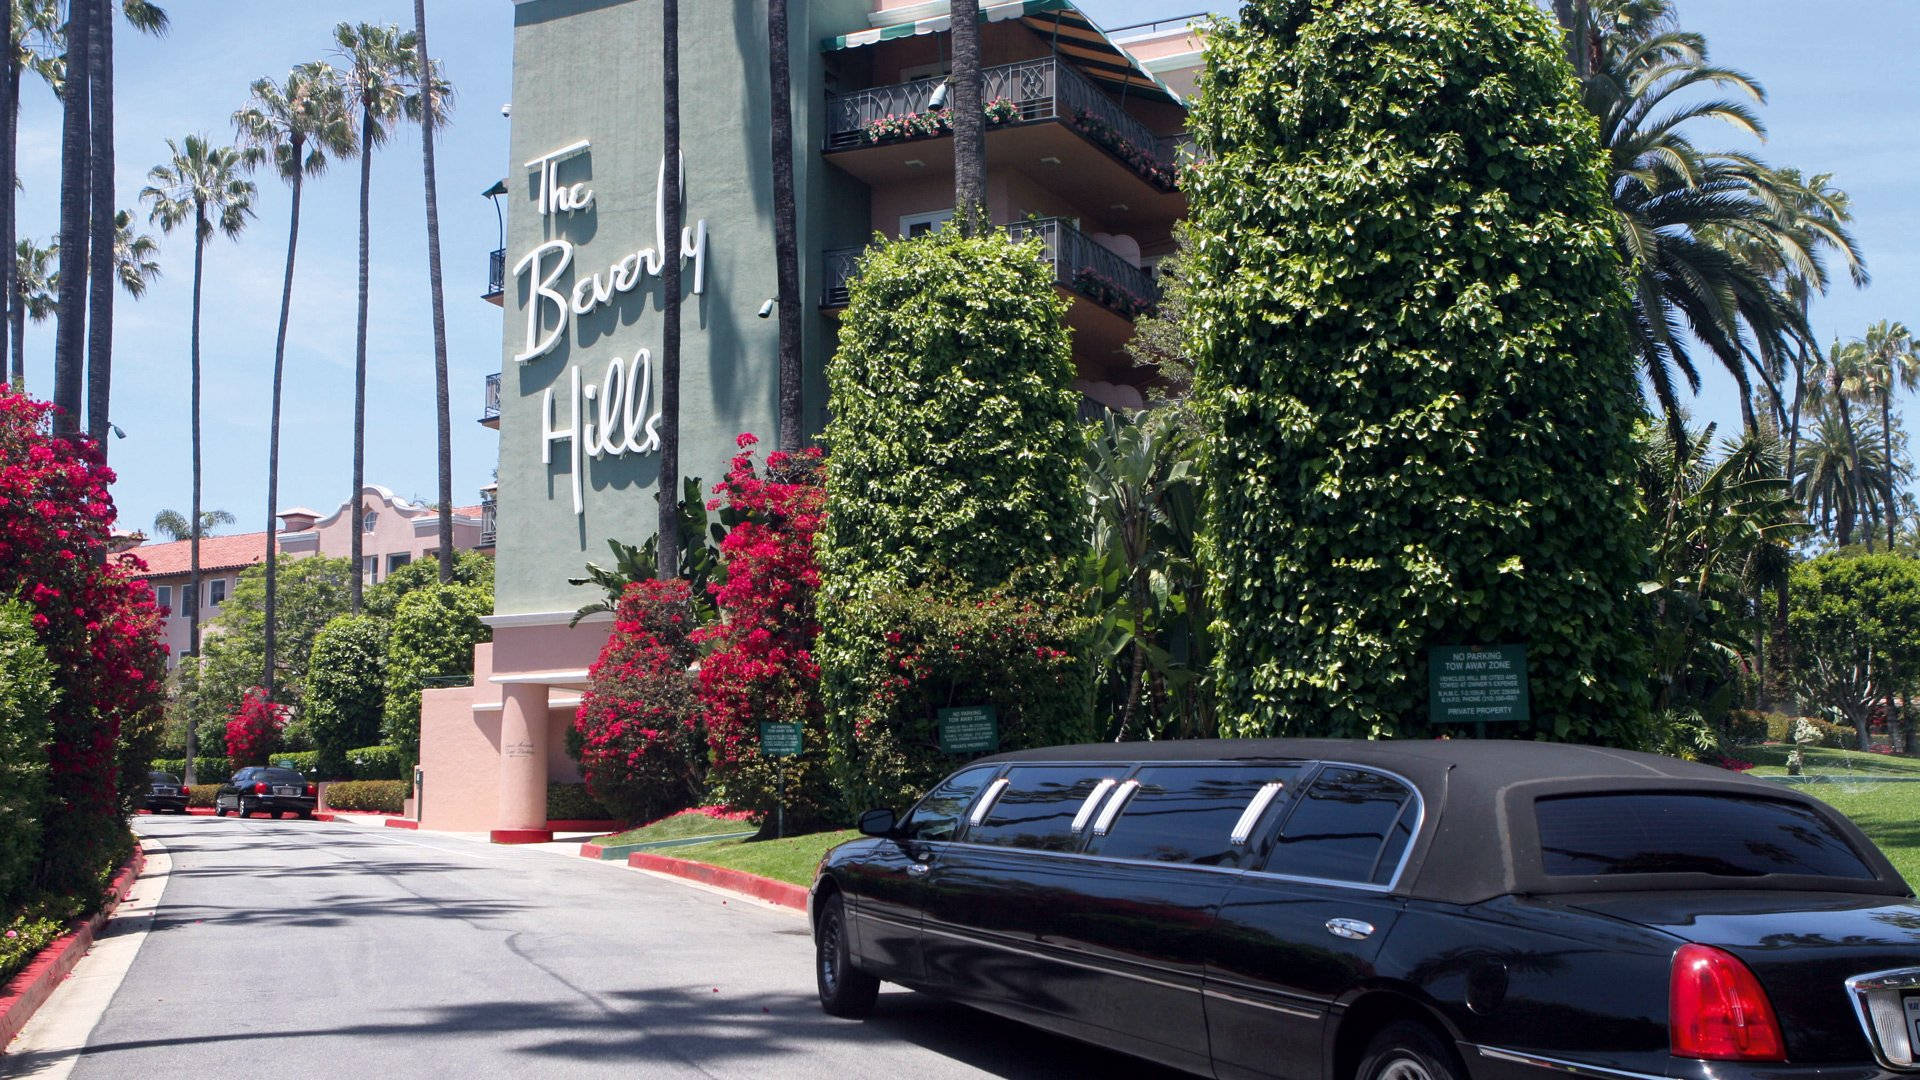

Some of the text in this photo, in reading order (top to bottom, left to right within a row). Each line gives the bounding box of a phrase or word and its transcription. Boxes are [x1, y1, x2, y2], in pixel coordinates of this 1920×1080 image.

[523, 139, 593, 215] The
[513, 149, 707, 362] Beverly
[542, 347, 663, 516] Hills
[1445, 660, 1512, 671] TOW AWAY ZONE
[1452, 652, 1502, 661] NO PARKING
[1476, 706, 1513, 714] PROPERTY
